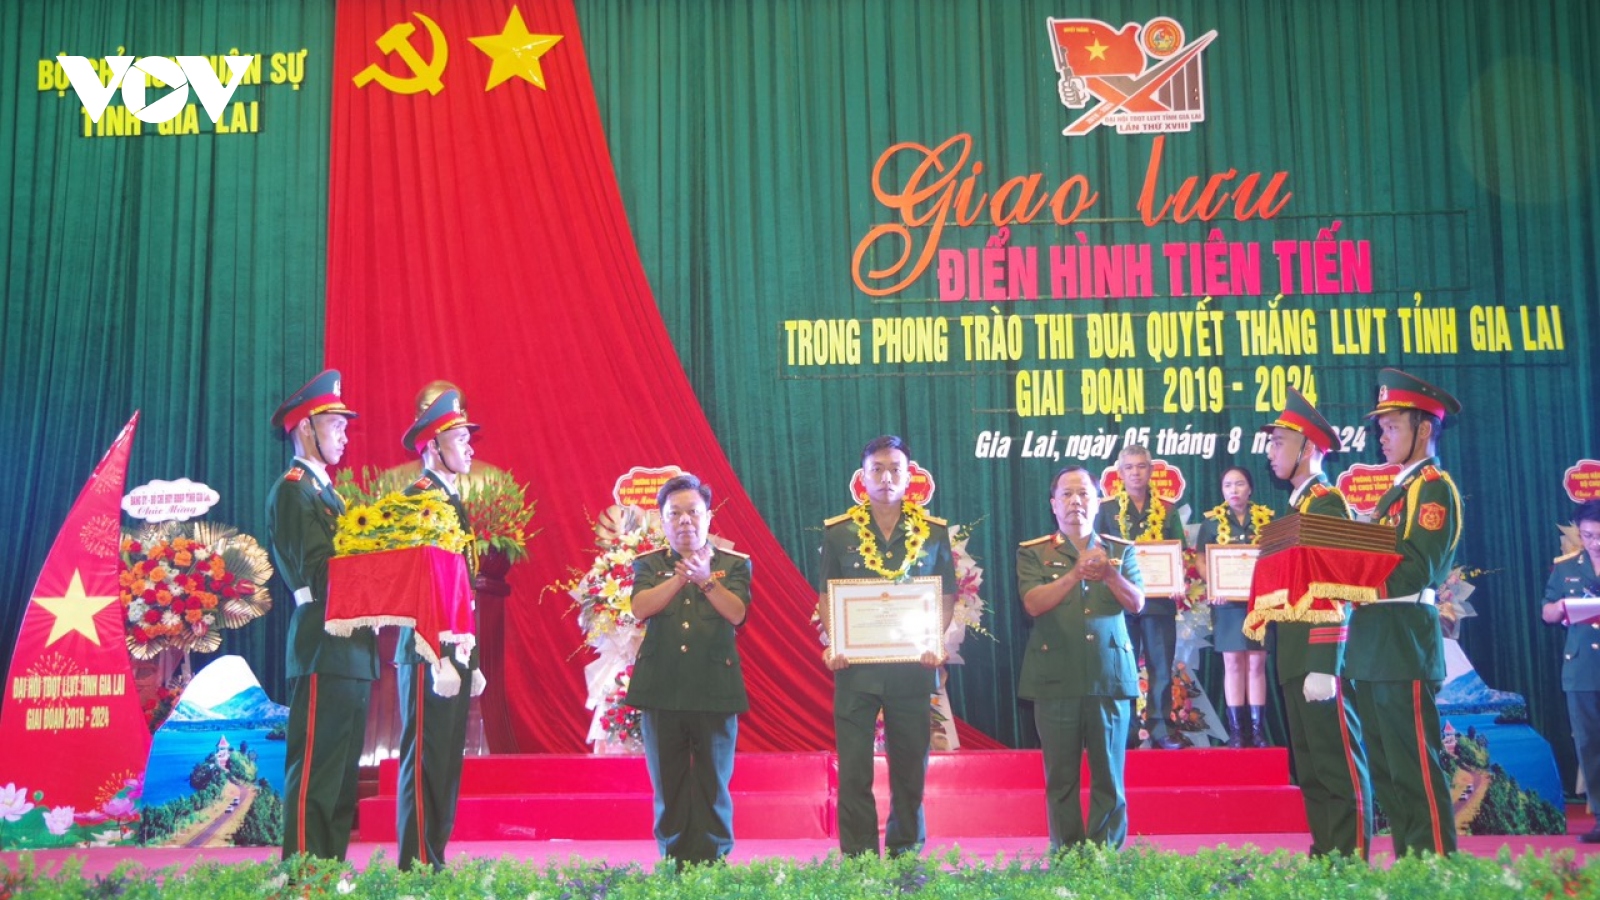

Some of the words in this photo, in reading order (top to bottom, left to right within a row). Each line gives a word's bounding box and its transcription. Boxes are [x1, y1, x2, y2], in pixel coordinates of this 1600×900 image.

[270, 48, 308, 91] SỰ
[216, 101, 259, 133] LAI
[1164, 121, 1188, 130] XVIII
[852, 133, 1099, 296] Giao
[1137, 135, 1292, 227] lưu
[937, 225, 1038, 301] ĐIỂN
[1050, 231, 1154, 299] HÌNH
[1162, 228, 1262, 297] TIÊN
[1273, 220, 1372, 294] TIẾN
[784, 319, 861, 365] TRONG
[872, 317, 949, 364] PHONG
[960, 305, 1023, 361] TRÀO
[1035, 313, 1074, 360] THI
[1086, 312, 1136, 359] ĐUA
[1146, 296, 1224, 363] QUYẾT
[1236, 293, 1318, 357] THẮNG
[1330, 308, 1387, 355] LLVT
[1398, 292, 1458, 354] TỈNH
[1469, 305, 1512, 352] GIA
[1519, 305, 1565, 351] LAI
[1015, 369, 1065, 417] GIAI
[1081, 368, 1145, 422] ĐOẠN
[1163, 366, 1224, 413] 2019
[975, 430, 1012, 459] Gia
[1021, 429, 1060, 462] Lai,
[1064, 428, 1118, 460] ngày
[1122, 427, 1151, 450] 05
[1155, 425, 1217, 460] tháng
[1227, 426, 1242, 454] 8
[99, 674, 112, 696] GIA
[112, 673, 126, 696] LAI
[26, 708, 42, 730] GIAI
[65, 706, 85, 729] 2019
[90, 705, 109, 728] 2024
